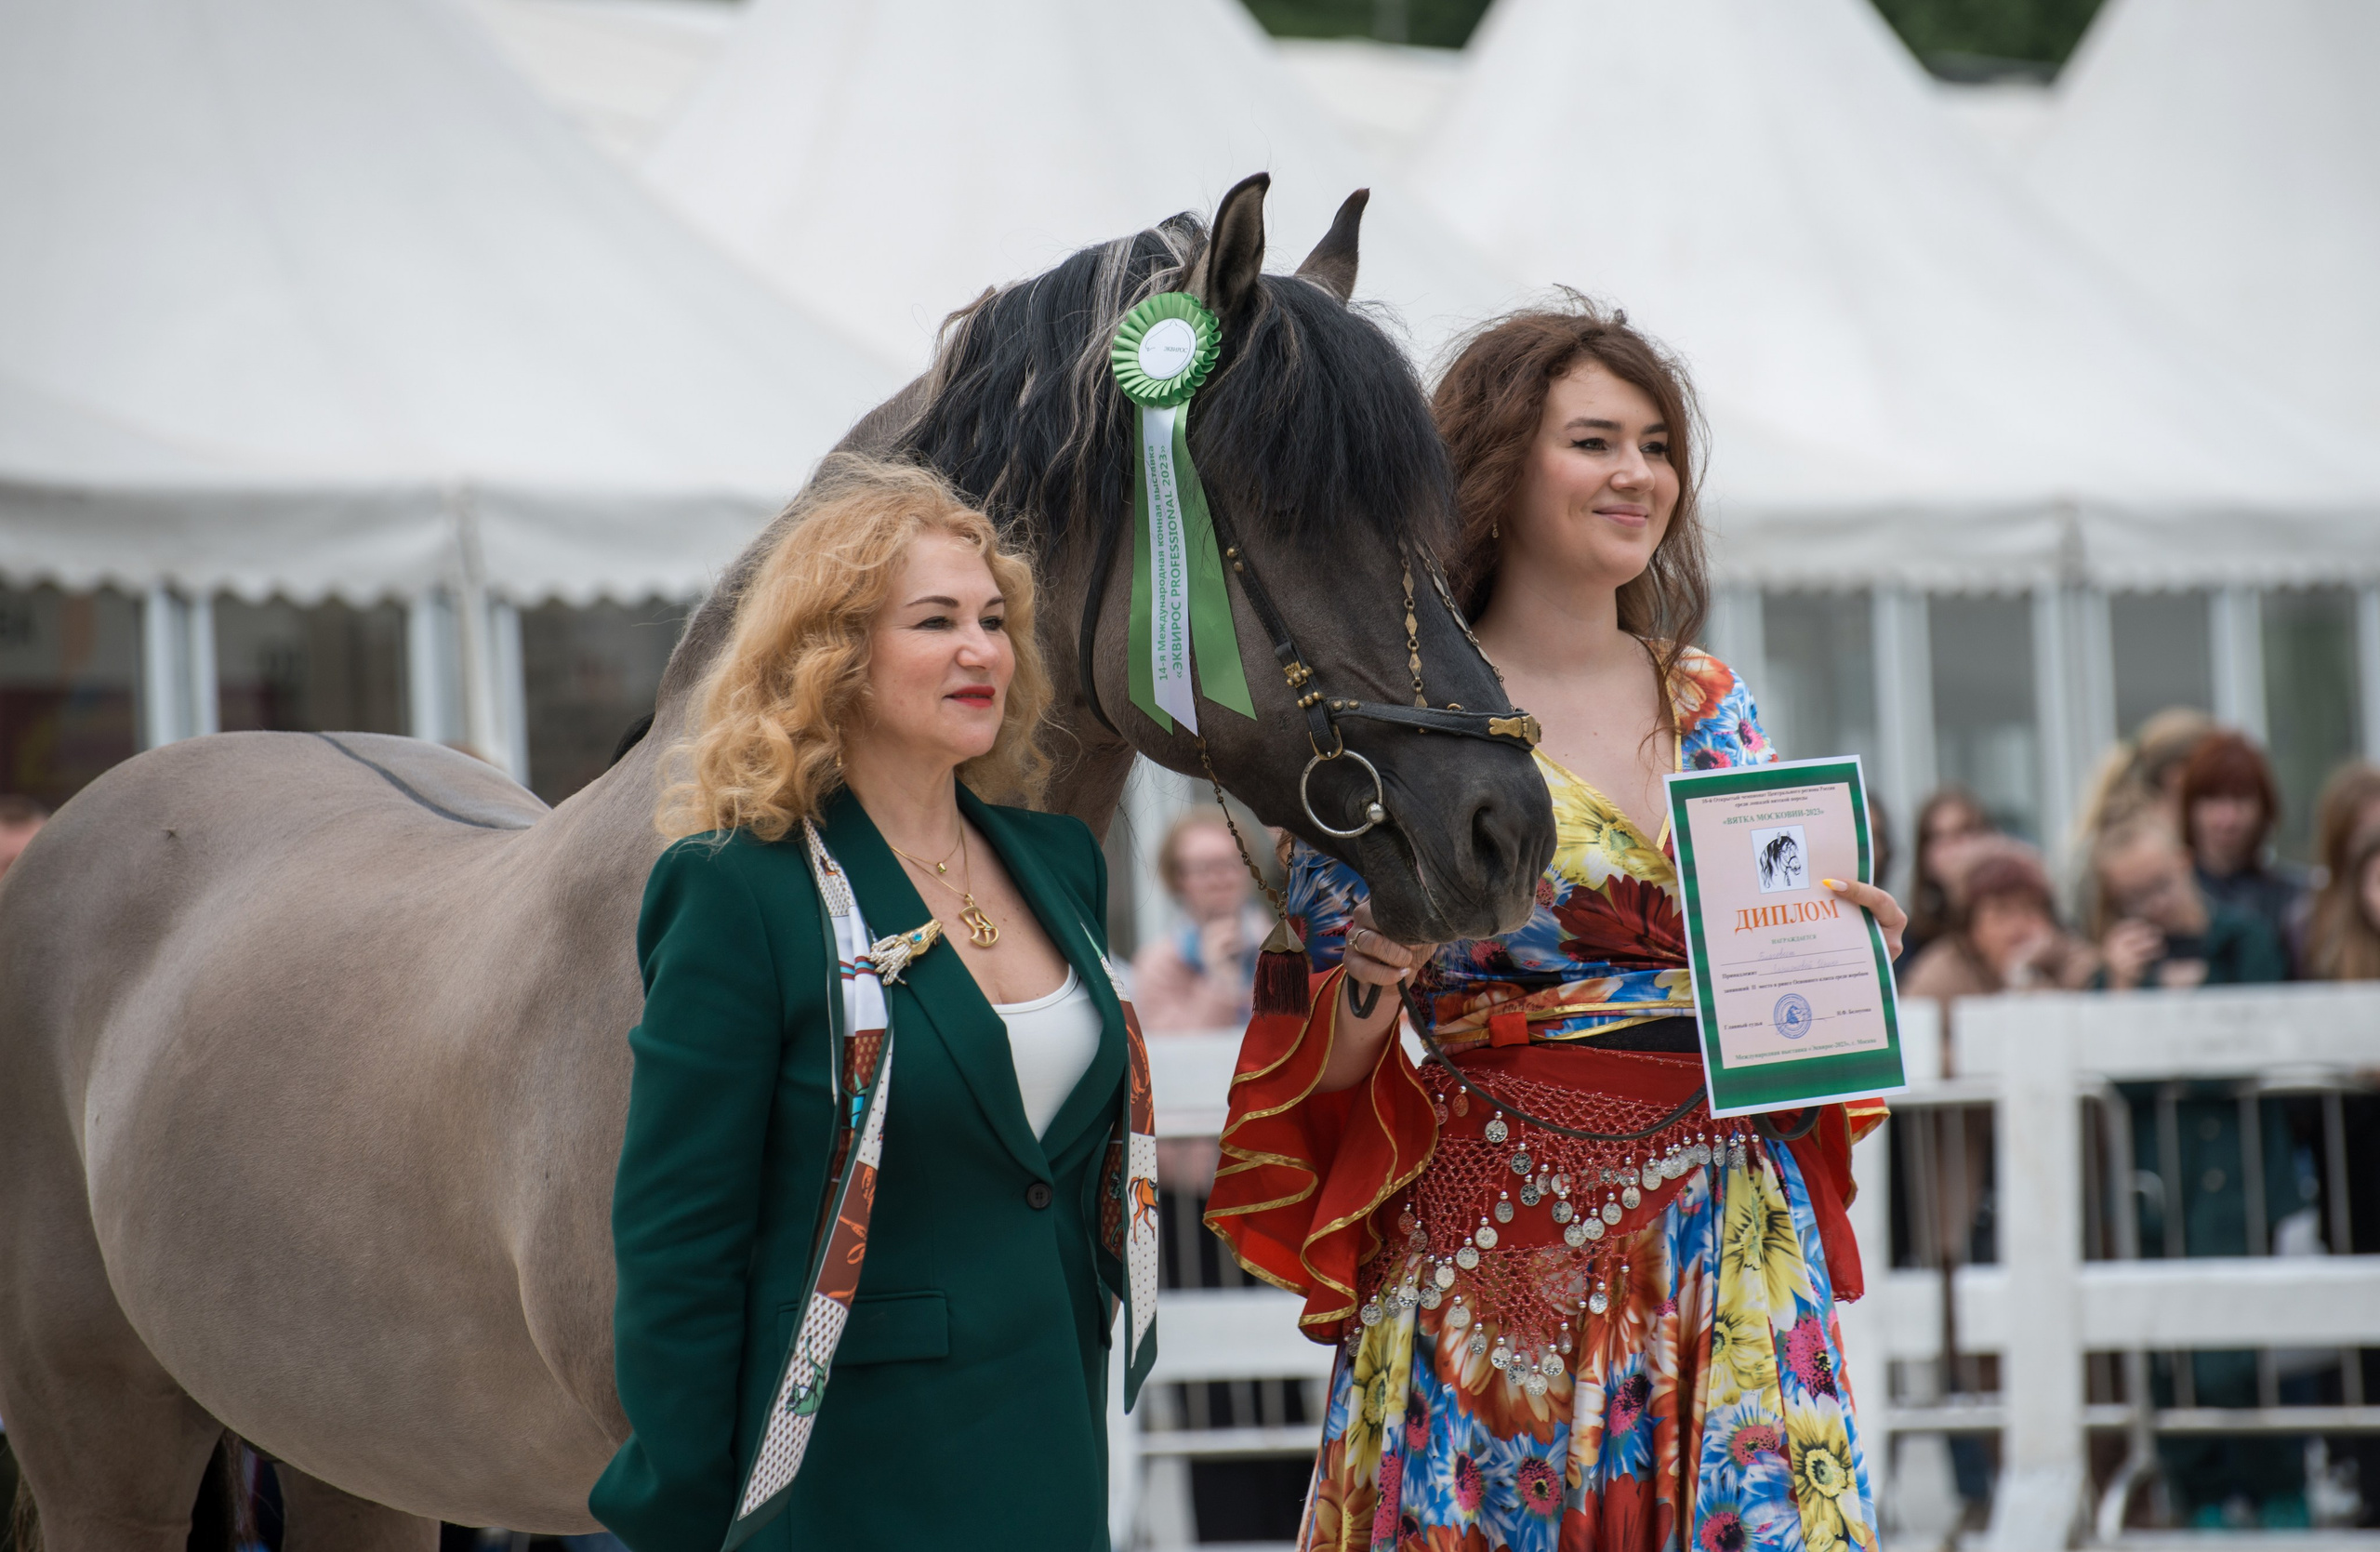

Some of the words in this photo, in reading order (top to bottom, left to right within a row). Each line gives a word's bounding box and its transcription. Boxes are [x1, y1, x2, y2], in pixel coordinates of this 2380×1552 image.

[1148, 444, 1161, 501] выставка
[1158, 444, 1171, 486] 2023»
[1156, 504, 1164, 547] конная
[1164, 490, 1181, 597] PROFESSIONAL
[1157, 550, 1169, 652] Международная
[1170, 601, 1183, 679] «ЭКВИРОС
[1158, 654, 1168, 681] 14-я
[1723, 816, 1755, 825] «ВЯТКА
[1756, 807, 1825, 822] МОСКОВИИ-2023»
[1734, 898, 1841, 935] ДИПЛОМ
[1771, 934, 1818, 945] НАГРАЖДАЕТСЯ
[1724, 1022, 1748, 1030] Главный
[1735, 1051, 1780, 1060] Международная
[1781, 1047, 1807, 1055] выставка
